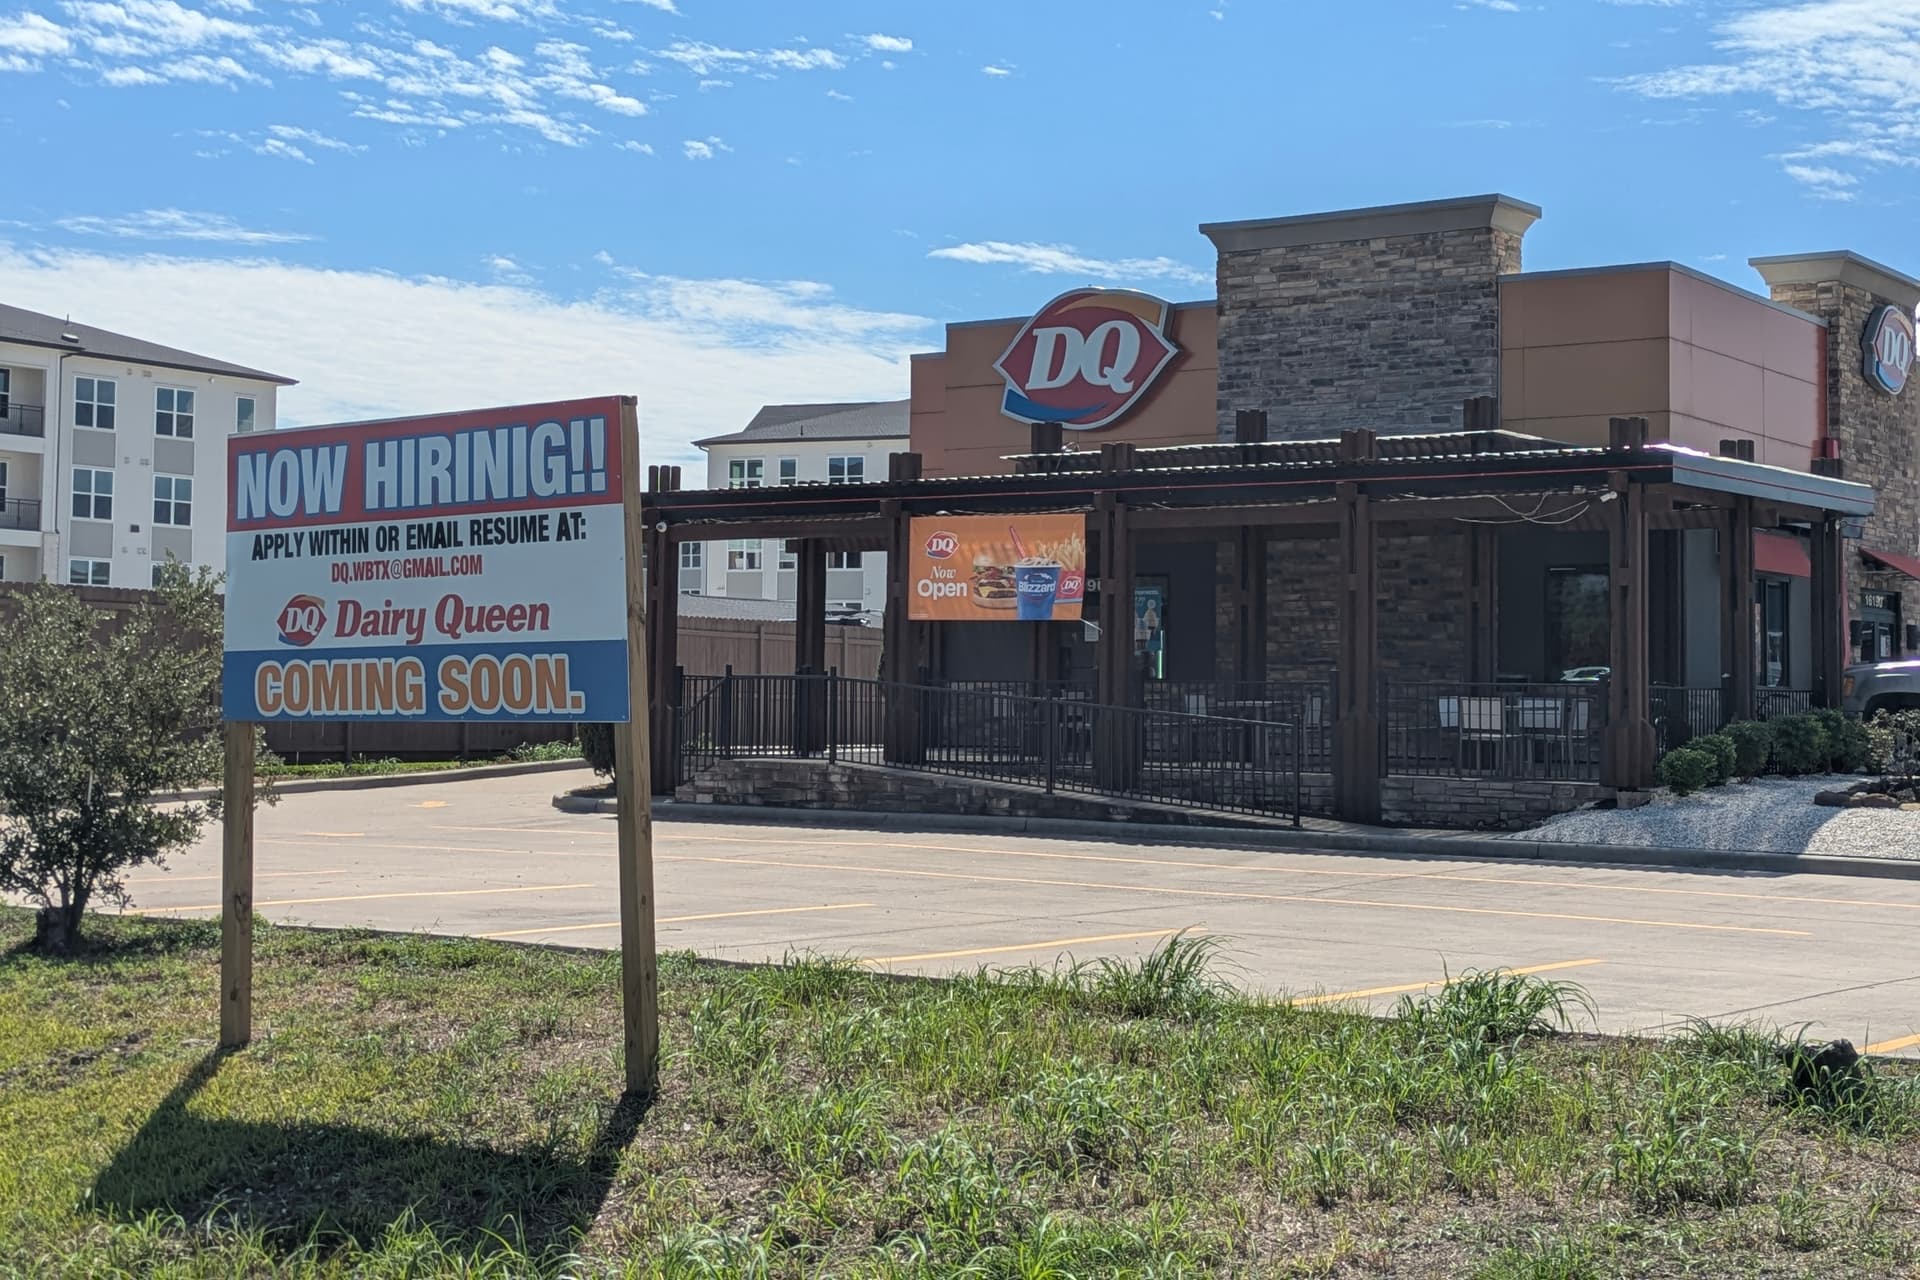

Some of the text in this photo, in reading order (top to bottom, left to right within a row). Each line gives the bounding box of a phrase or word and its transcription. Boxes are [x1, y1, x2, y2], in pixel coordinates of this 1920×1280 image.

[1025, 320, 1141, 394] DQ
[1883, 325, 1911, 377] DQ
[236, 416, 607, 521] NOW HIRINIG!!
[252, 512, 587, 561] APPLY WITHIN OR EMAIL RESUME AT:
[931, 538, 954, 553] DQ
[331, 554, 483, 584] DQ.WBTX@GMAIL.COM
[930, 565, 956, 579] Now
[917, 578, 968, 600] Open
[1018, 580, 1056, 593] Blizzard
[1064, 579, 1079, 590] DQ
[285, 606, 321, 636] DQ
[334, 594, 550, 645] Dairy Queen
[257, 655, 584, 716] COMING SOON.
